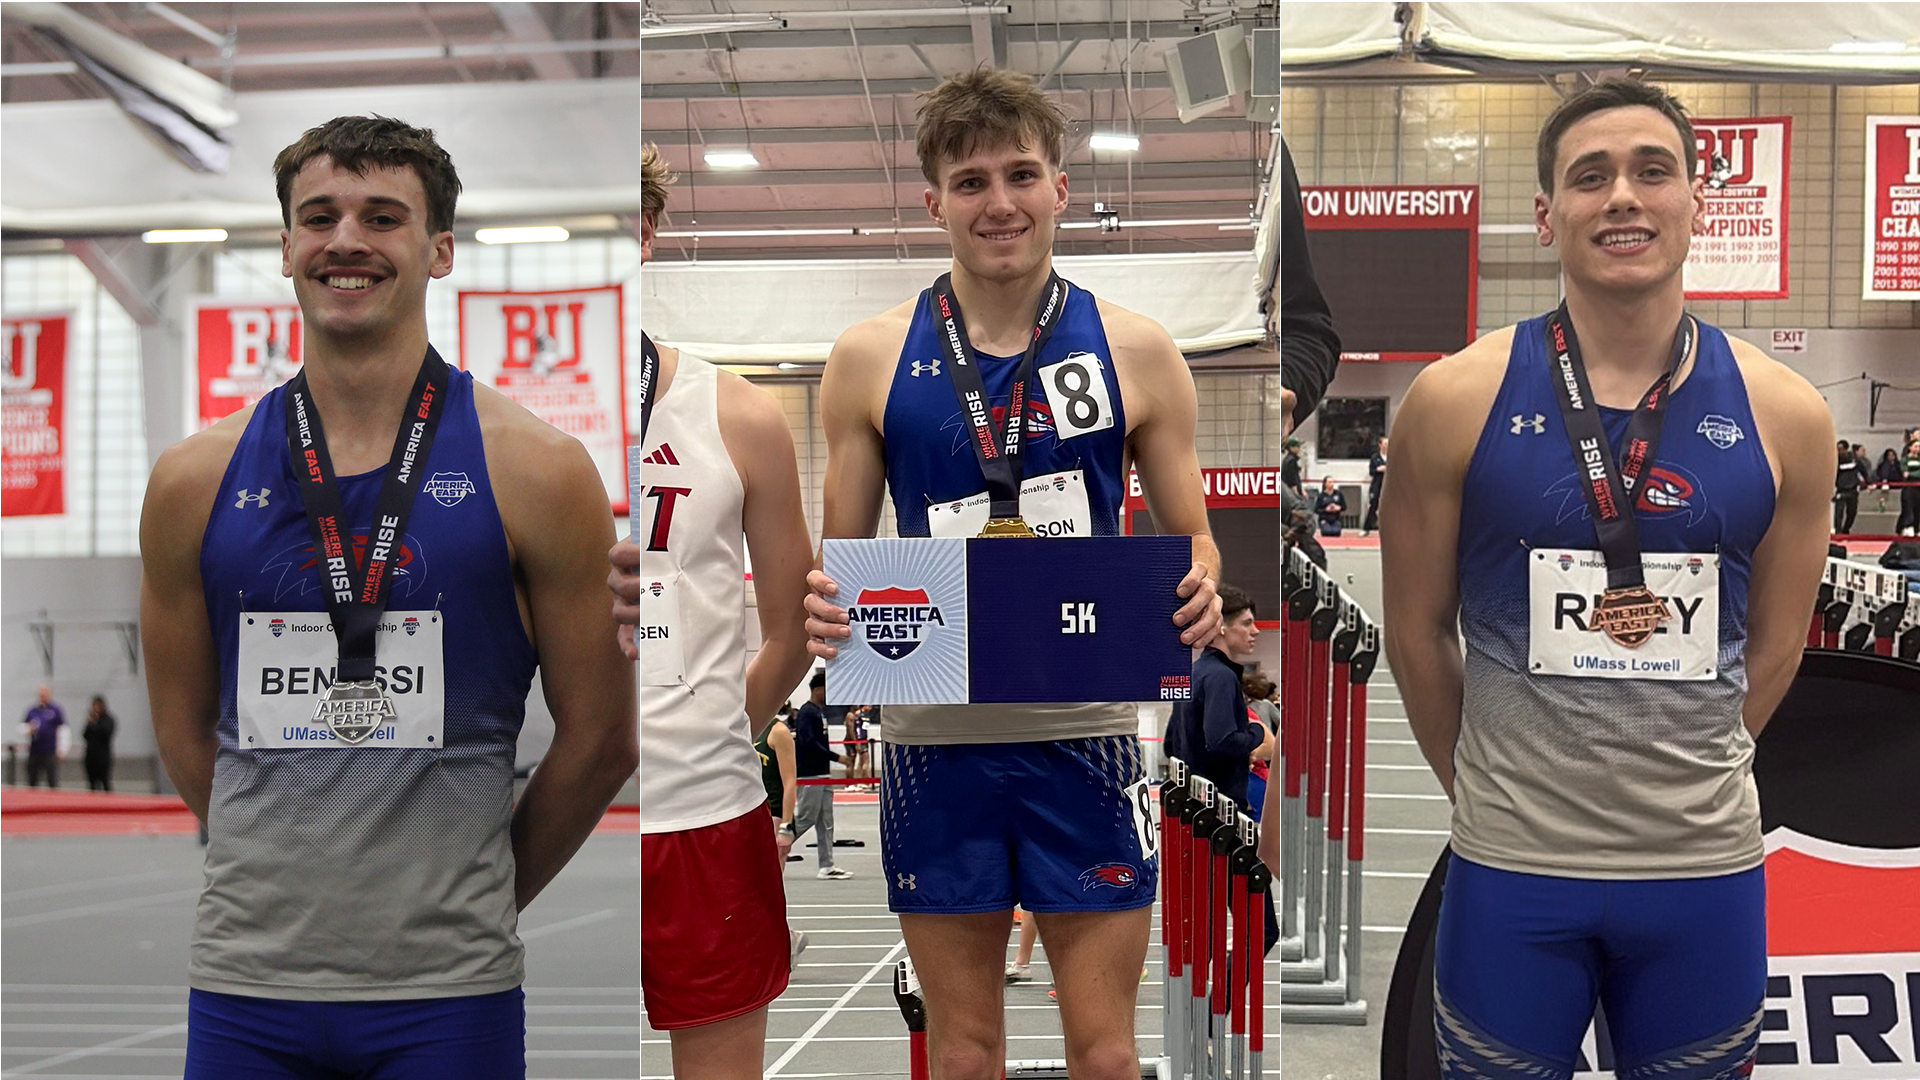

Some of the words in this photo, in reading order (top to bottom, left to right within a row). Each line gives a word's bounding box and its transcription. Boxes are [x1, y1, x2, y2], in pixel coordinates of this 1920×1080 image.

[1345, 190, 1473, 216] UNIVERSITY
[1039, 282, 1059, 326] AMERICA
[502, 303, 584, 368] BU
[945, 318, 967, 366] AMERICA
[1773, 331, 1804, 342] EXIT
[1054, 363, 1098, 428] 8
[1558, 352, 1584, 409] AMERICA
[965, 390, 989, 427] RISE
[294, 393, 313, 448] AMERICA
[304, 449, 323, 484] EAST
[398, 422, 426, 484] AMERICA
[417, 382, 436, 419] EAST
[1005, 416, 1021, 455] RISE
[1580, 437, 1606, 480] RISE
[427, 481, 473, 491] AMERICA
[325, 516, 343, 557] WHERE
[372, 515, 399, 561] RISE
[327, 557, 353, 603] RISE
[1580, 560, 1606, 569] Indoo
[361, 561, 380, 602] WHERE
[291, 624, 324, 632] Indoor
[847, 606, 945, 627] AMERICA
[1061, 602, 1096, 634] 5K
[1594, 605, 1666, 625] AMERICA
[1612, 617, 1651, 632] EAST
[866, 624, 922, 639] EAST
[1573, 656, 1626, 671] UMass
[1631, 659, 1680, 671] Lowell
[261, 666, 424, 695] BENSSI
[1160, 687, 1191, 699] RISE
[317, 698, 391, 717] AMERICA
[332, 713, 375, 726] EAST
[283, 727, 337, 740] UMass
[1137, 784, 1154, 851] 8
